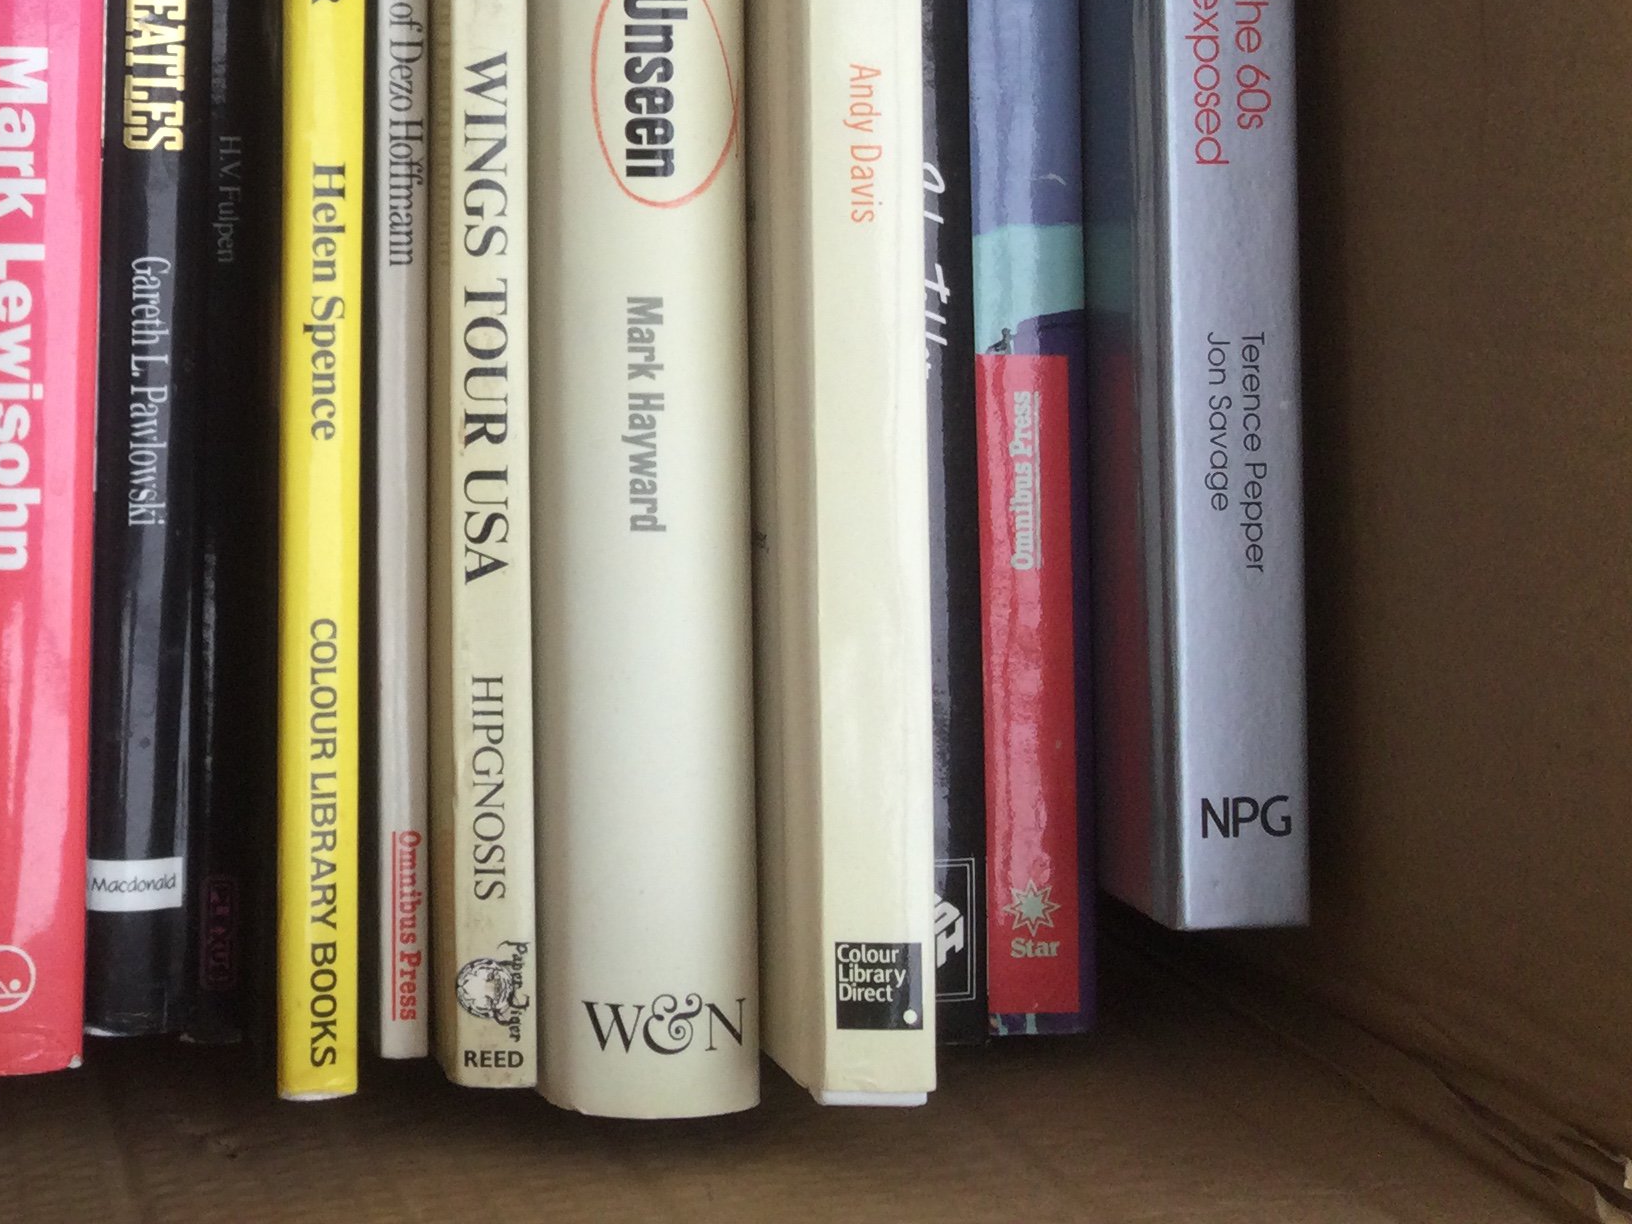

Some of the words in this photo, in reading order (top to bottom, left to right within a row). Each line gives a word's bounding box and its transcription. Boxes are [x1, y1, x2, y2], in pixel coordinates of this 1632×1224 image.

[389, 2, 423, 33] of
[389, 39, 424, 112] Dezo
[843, 64, 882, 132] Andy
[1236, 64, 1271, 130] 60s
[388, 117, 425, 267] Hoffmann
[463, 51, 509, 257] WINGS
[850, 144, 883, 223] Davis
[310, 162, 346, 283] Helen
[131, 354, 168, 376] L.
[303, 296, 346, 440] Spence
[463, 278, 509, 449] TOUR
[627, 297, 664, 380] Mark
[1207, 332, 1232, 386] Jon
[1009, 391, 1034, 456] Press
[1241, 332, 1266, 452] Terence
[622, 392, 667, 532] Hayward
[1205, 395, 1233, 512] Savage
[464, 466, 510, 585] USA
[1010, 463, 1035, 570] Omnibus
[1239, 462, 1267, 572] Pepper
[310, 618, 337, 761] COLOUR
[472, 676, 506, 901] HIPGNOSIS
[1200, 795, 1293, 838] NPG
[90, 878, 176, 891] Macdonald
[310, 773, 337, 930] LIBRARY
[399, 831, 421, 944] Omnibus
[399, 950, 421, 1021] Press
[837, 944, 899, 963] Colour
[837, 964, 906, 986] Library
[1011, 938, 1060, 958] Star
[310, 941, 337, 1067] BOOKS
[839, 983, 893, 1002] Direct
[464, 1050, 524, 1068] REED
